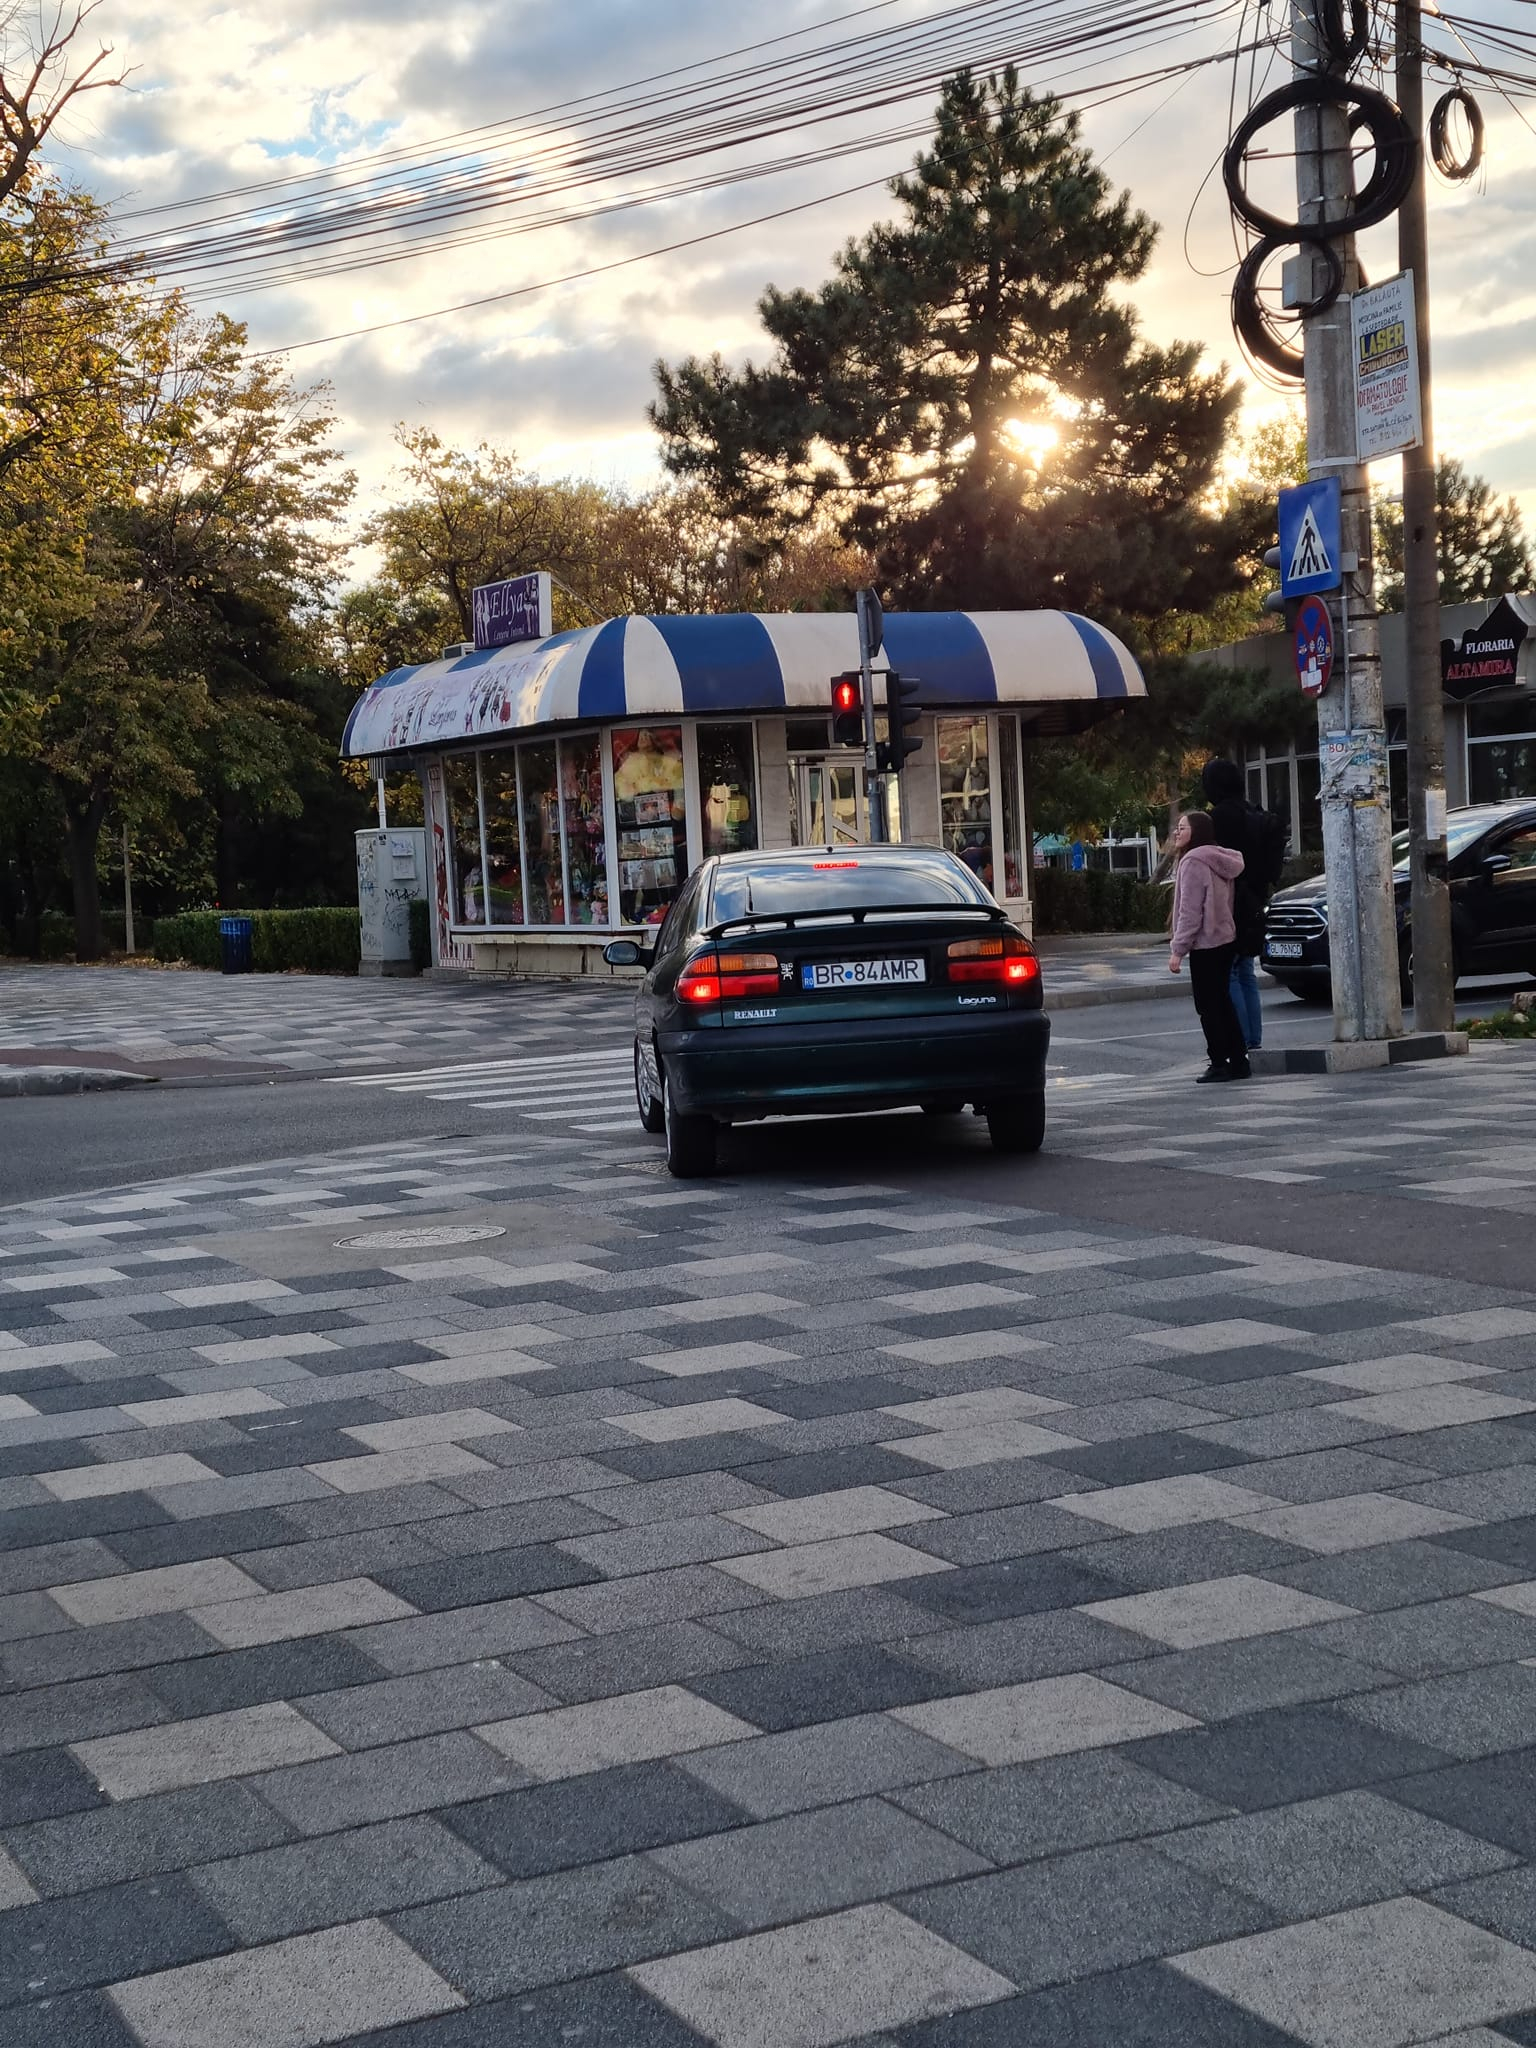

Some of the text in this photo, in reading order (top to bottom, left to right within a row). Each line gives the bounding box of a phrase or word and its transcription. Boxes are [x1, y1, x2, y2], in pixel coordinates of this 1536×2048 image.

[1360, 322, 1404, 360] LASER
[1360, 347, 1408, 377] CHIRURGICAL
[1358, 374, 1408, 408] DERMATOLOGIE
[490, 583, 523, 626] Ellya
[1466, 638, 1515, 655] FLORARIA
[1447, 658, 1514, 680] ALTAMIRA
[815, 965, 845, 985] BR
[854, 960, 919, 982] 84AMR
[734, 1008, 777, 1020] RENAULT
